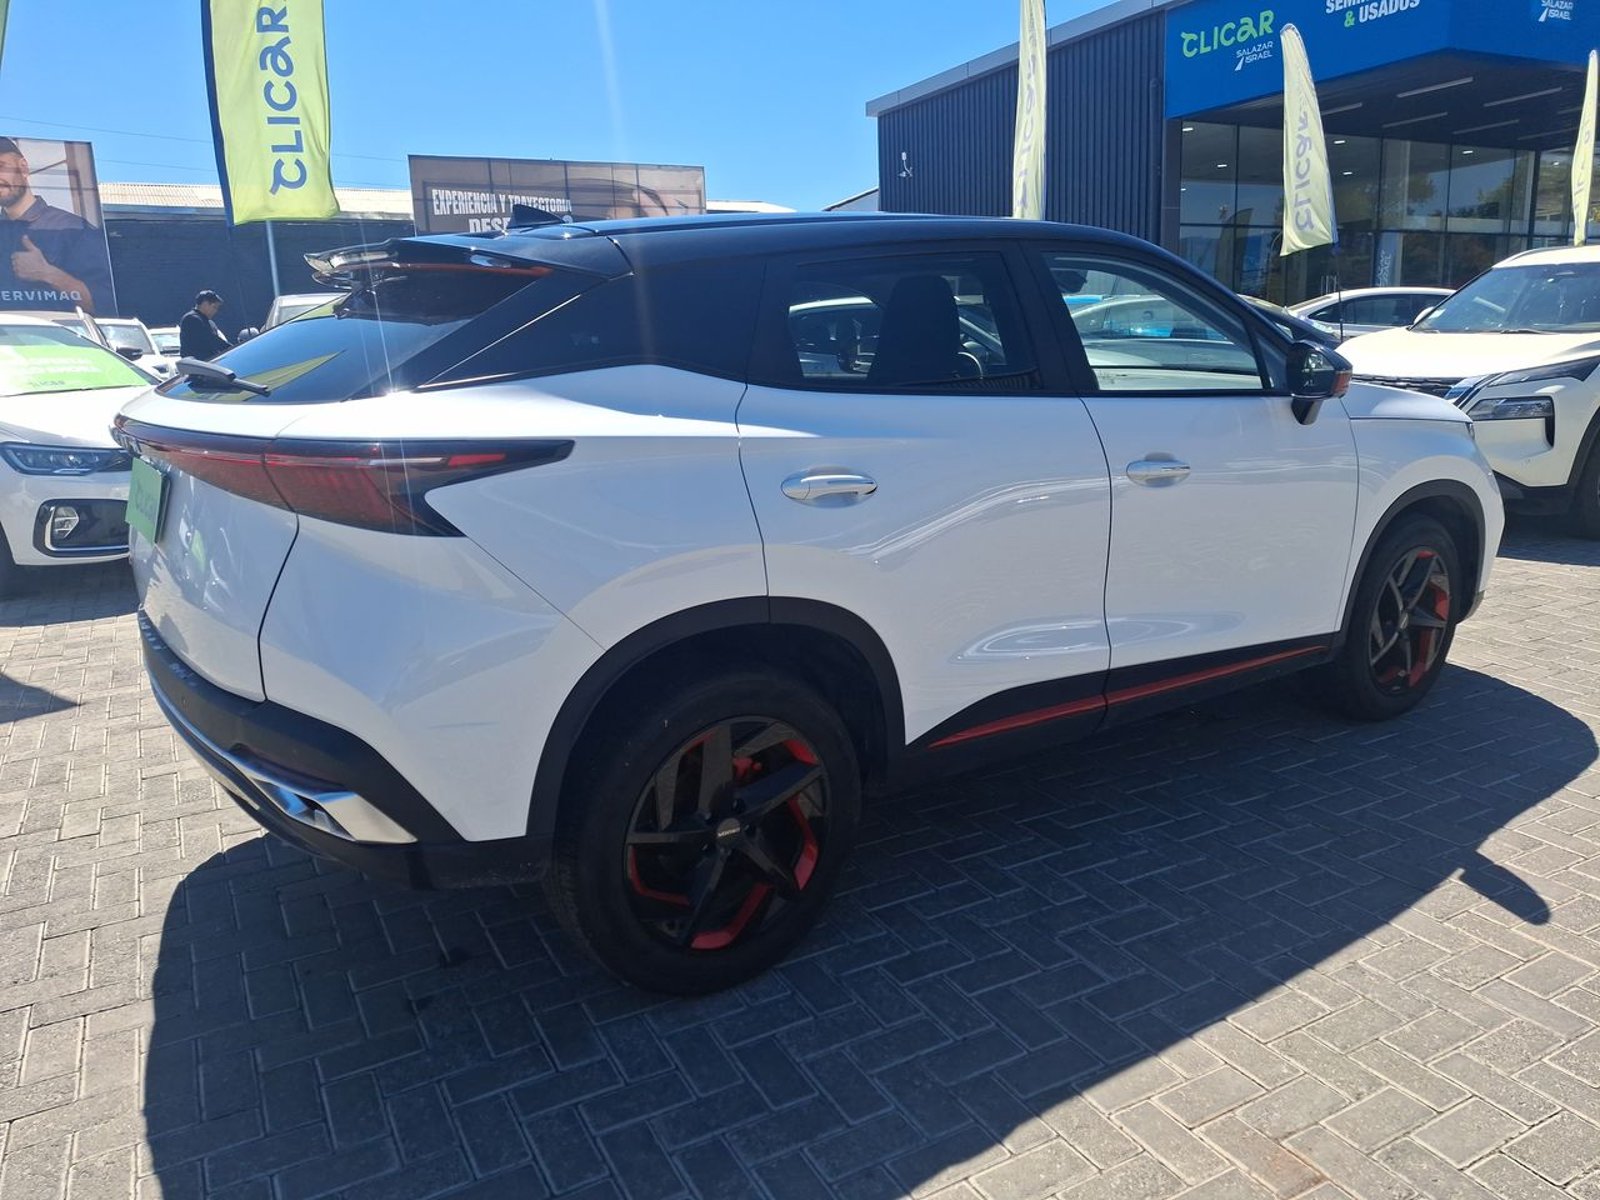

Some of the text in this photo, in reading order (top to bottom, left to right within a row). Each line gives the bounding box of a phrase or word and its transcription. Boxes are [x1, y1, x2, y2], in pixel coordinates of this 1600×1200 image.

[1344, 10, 1355, 28] &
[1235, 41, 1274, 58] SALAZAR
[432, 189, 498, 215] EXPERIENCIA
[499, 194, 507, 213] Y
